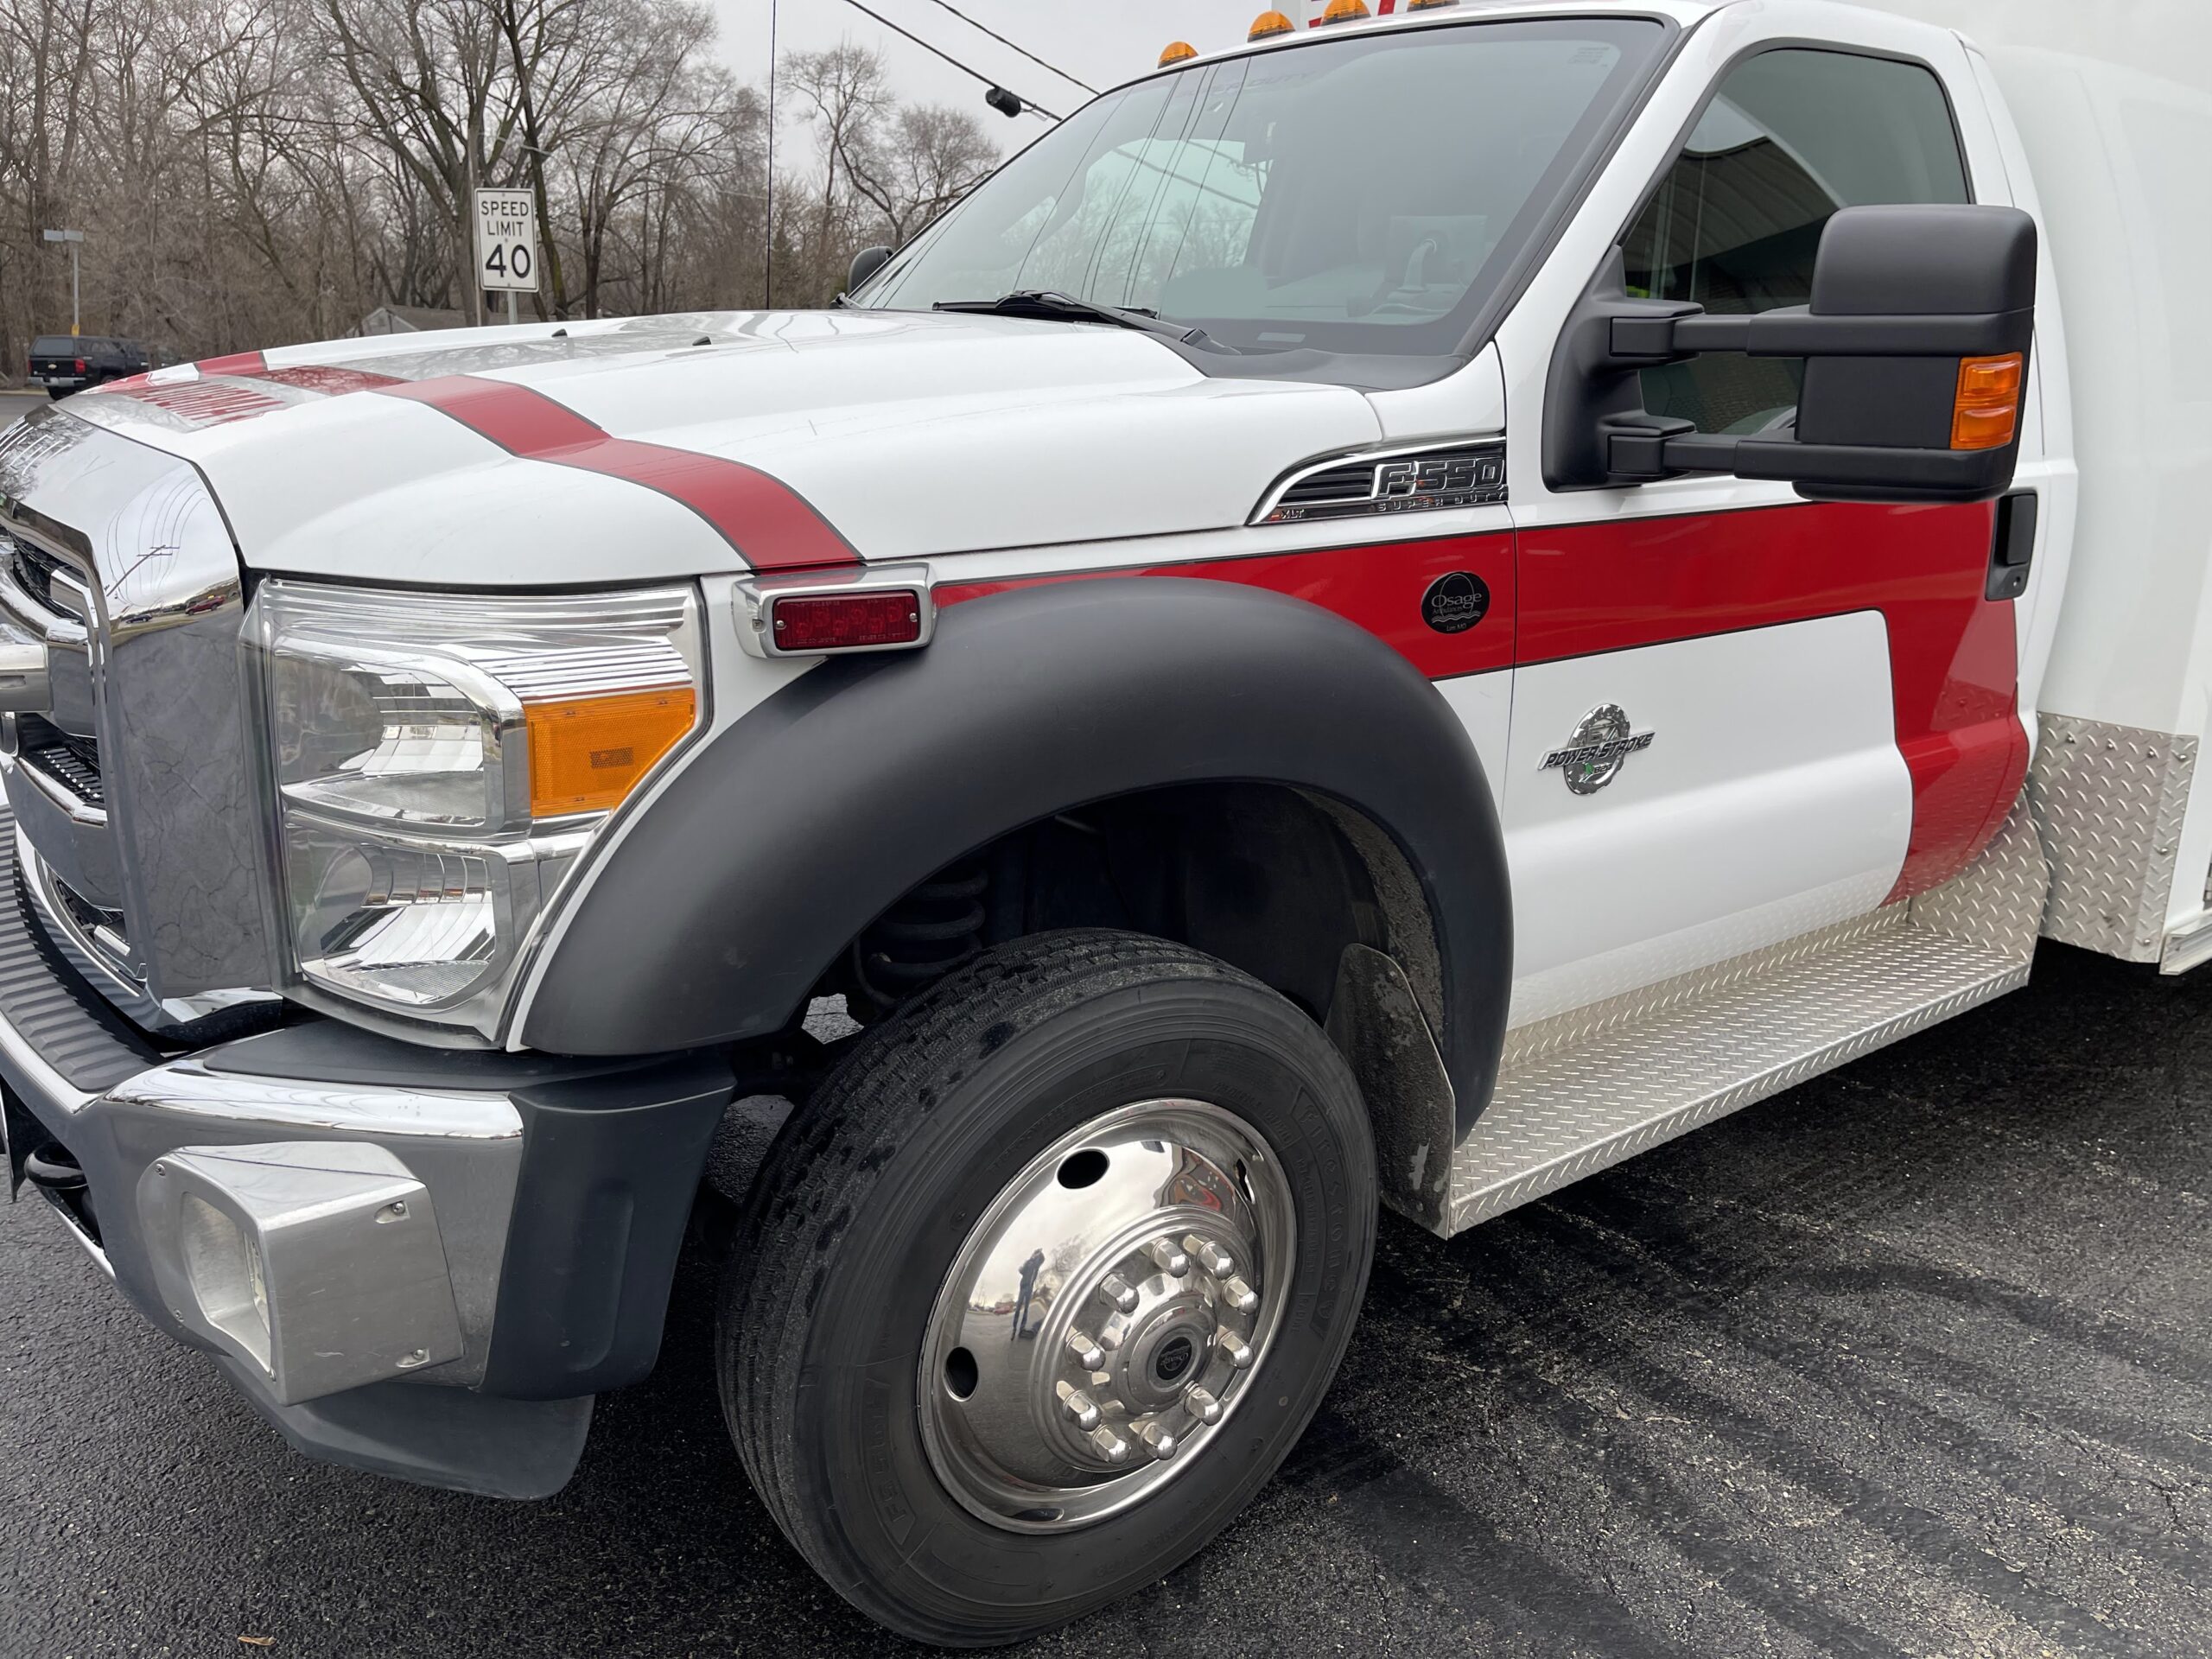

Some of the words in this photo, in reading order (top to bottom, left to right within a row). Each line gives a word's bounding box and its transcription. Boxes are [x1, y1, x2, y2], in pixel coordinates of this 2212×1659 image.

[481, 200, 529, 216] SPEED
[487, 220, 524, 237] LIMIT
[486, 244, 531, 278] 40
[1378, 498, 1444, 512] SUPER
[1454, 492, 1504, 505] DUTY
[1279, 509, 1305, 519] XLT
[1432, 593, 1482, 609] Osage
[1543, 745, 1599, 768] POWER
[1599, 733, 1655, 758] STROKE
[1298, 1103, 1346, 1292] Firestone
